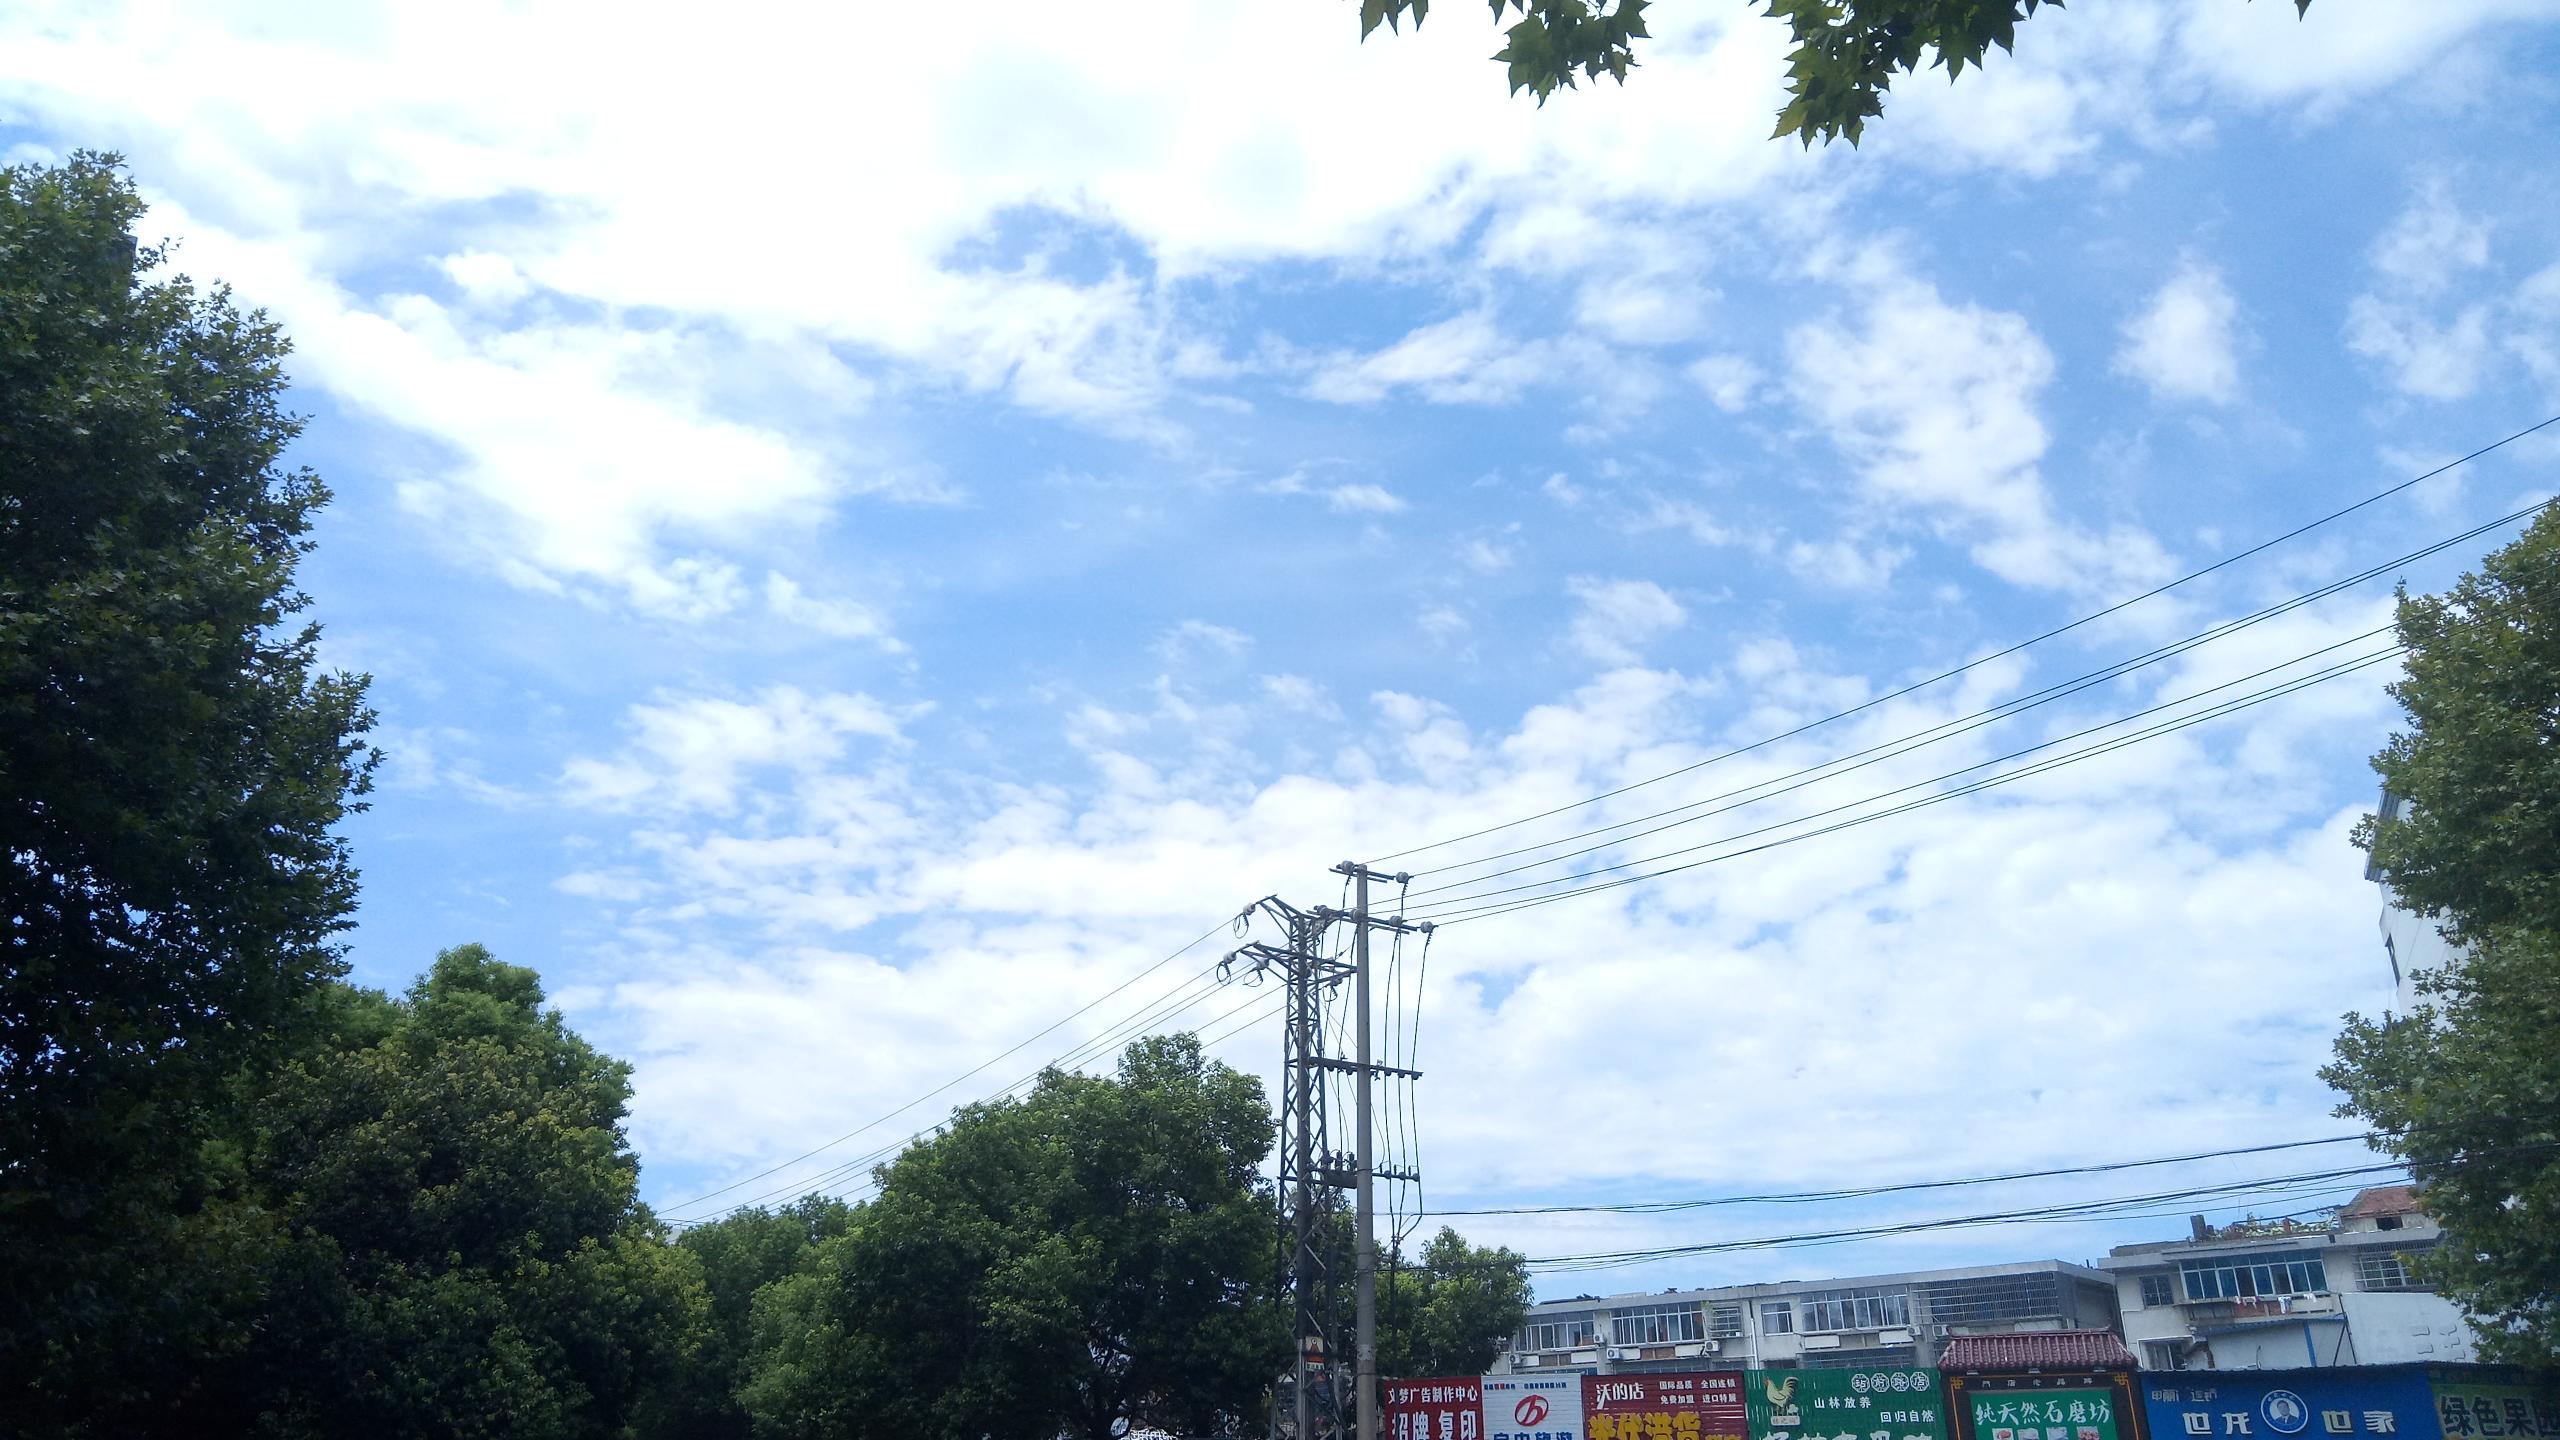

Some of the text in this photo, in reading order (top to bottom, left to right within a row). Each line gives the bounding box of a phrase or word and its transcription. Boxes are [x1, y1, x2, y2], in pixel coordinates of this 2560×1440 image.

[1659, 1378, 1736, 1390] 国际品质 全国连锁
[1595, 1382, 1645, 1410] 沃的店
[1660, 1394, 1695, 1405] 免费加盟
[1814, 1396, 1872, 1409] 山林放养
[1880, 1409, 1935, 1423] 回归自然
[1975, 1398, 2111, 1426] 纯天然石磨坊
